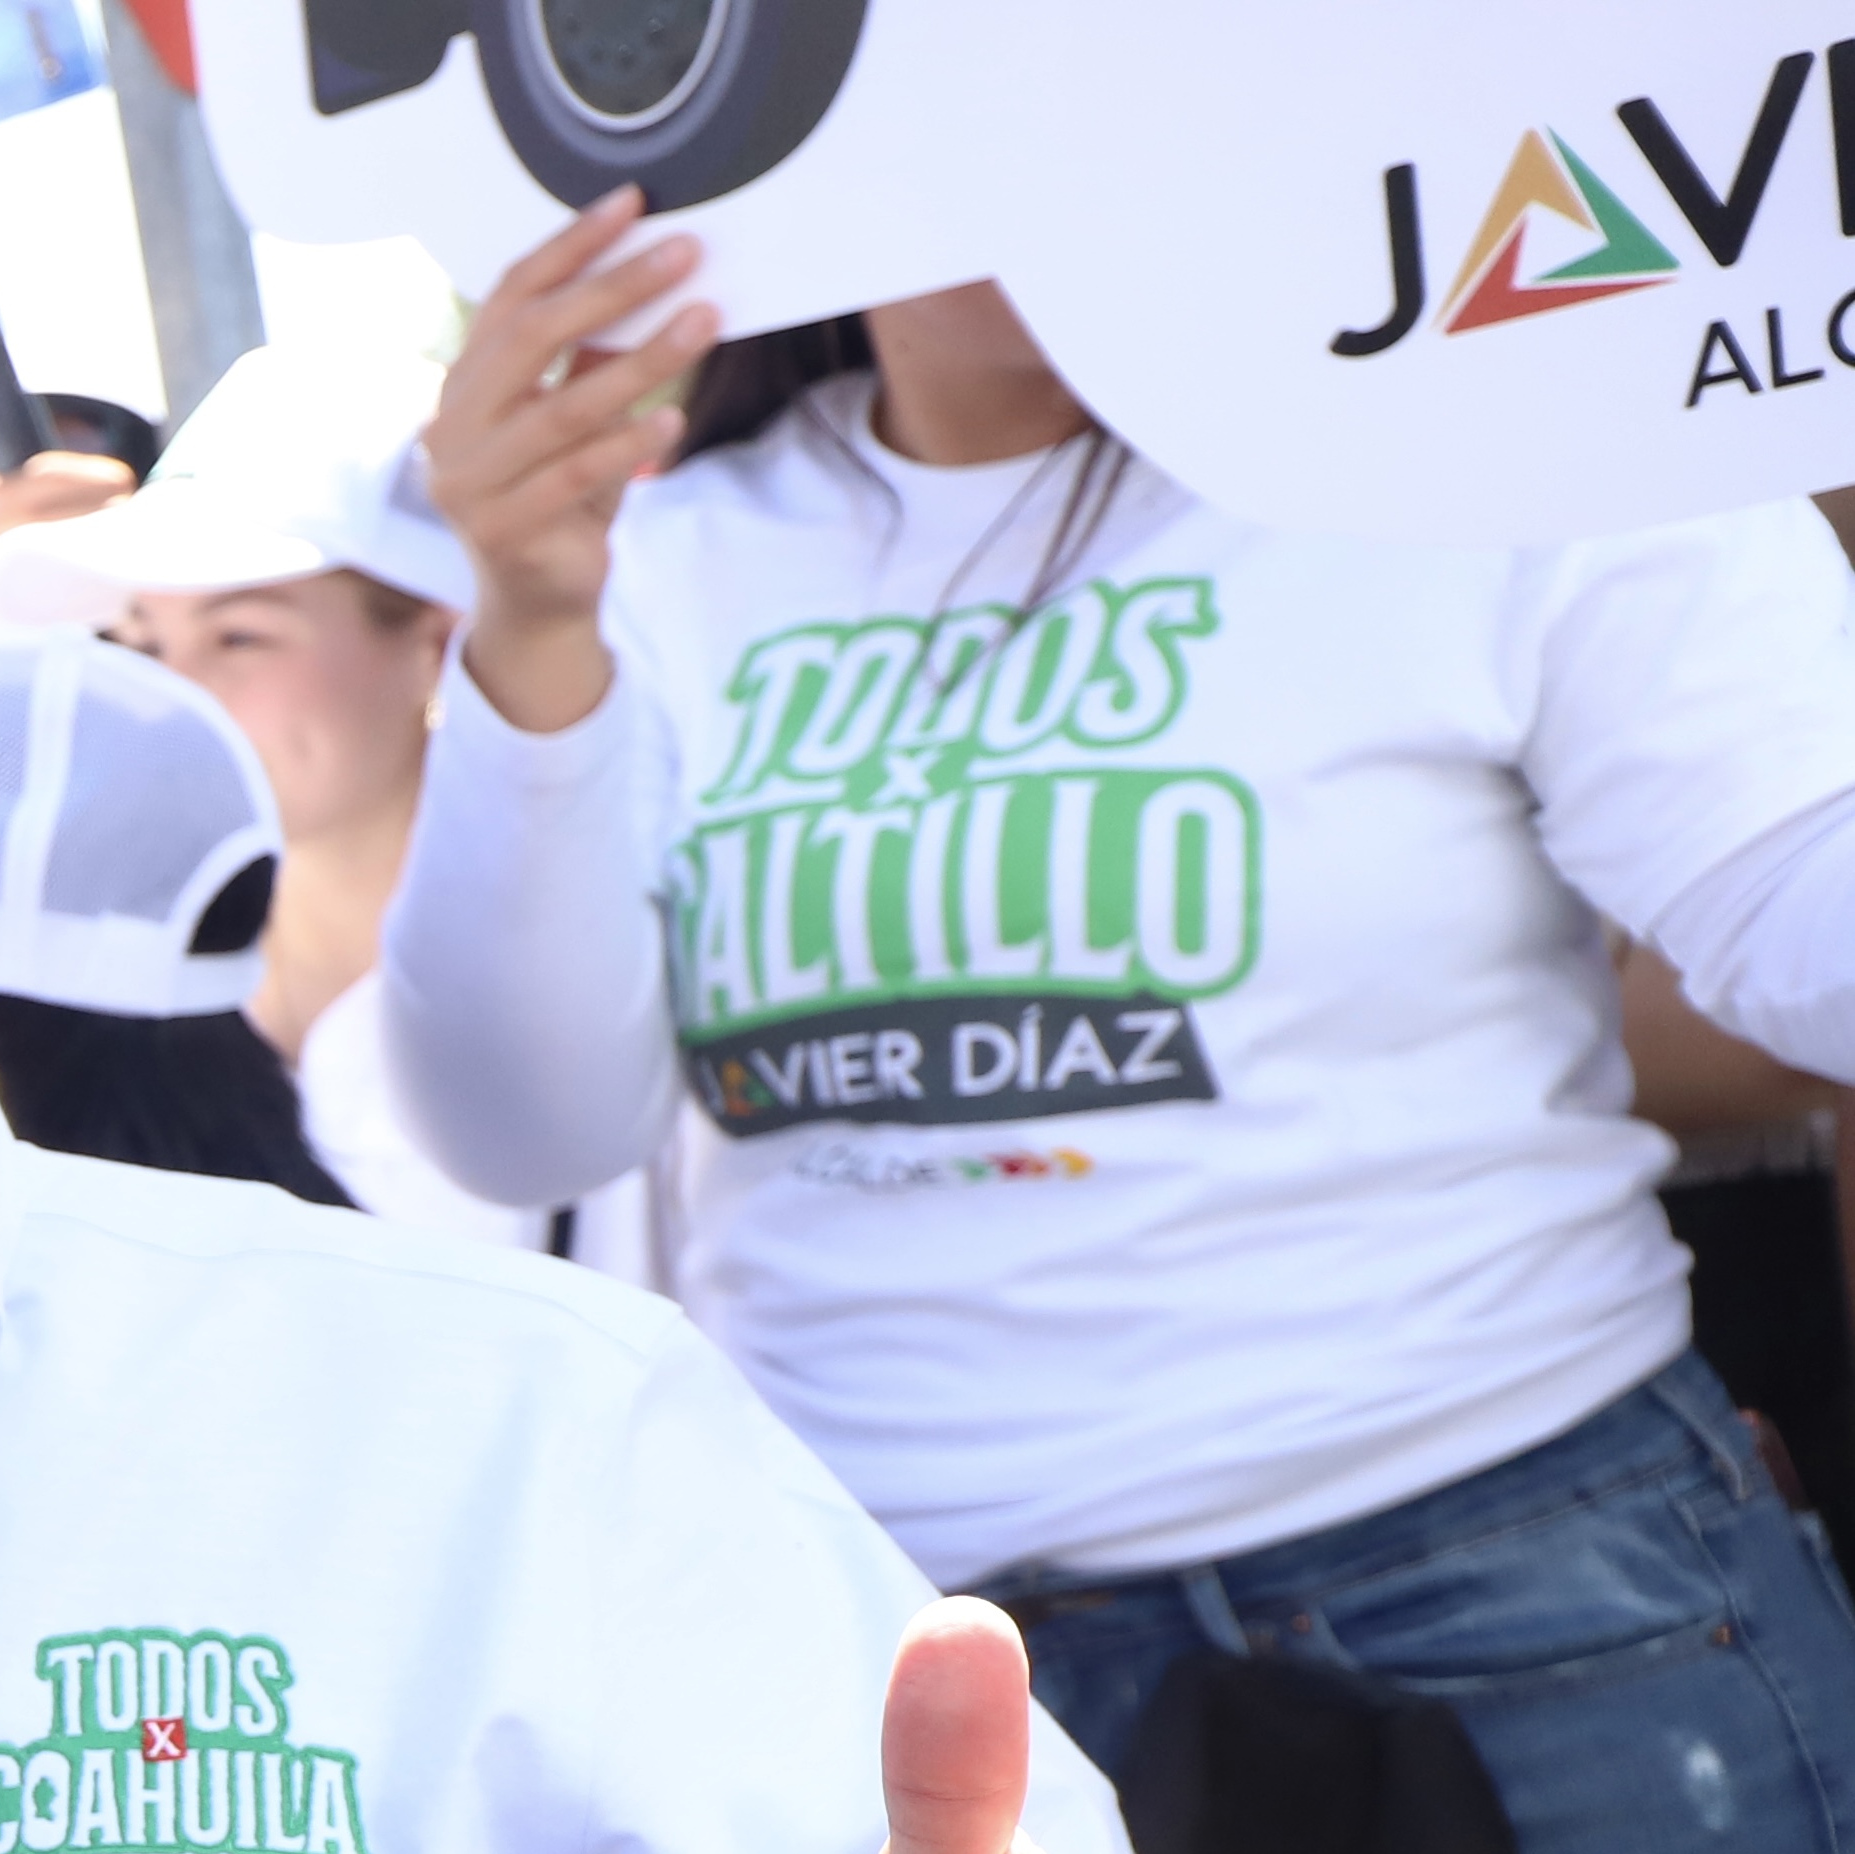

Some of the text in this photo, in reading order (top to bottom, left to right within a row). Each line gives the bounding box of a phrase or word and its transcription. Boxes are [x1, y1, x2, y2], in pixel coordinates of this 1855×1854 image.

[703, 576, 1221, 805] TODOS
[663, 770, 1259, 1035] ALTILLO
[951, 1003, 1183, 1098] DÍAZ
[39, 1632, 291, 1736] TODOS
